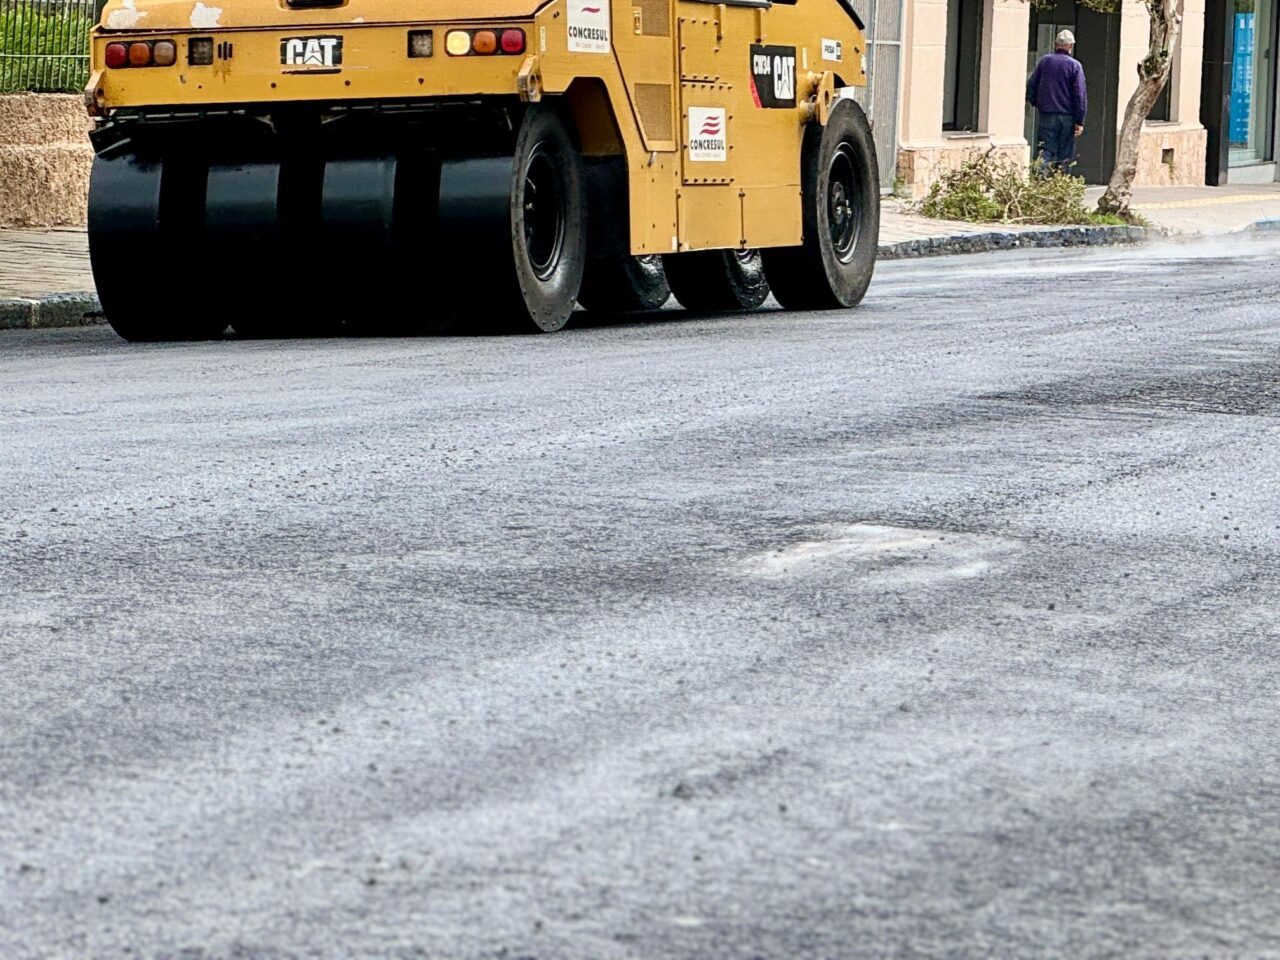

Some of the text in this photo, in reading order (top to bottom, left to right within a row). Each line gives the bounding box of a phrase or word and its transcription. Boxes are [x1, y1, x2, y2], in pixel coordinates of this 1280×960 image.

[568, 25, 608, 41] CONCRESUL
[285, 38, 337, 66] CAT
[773, 55, 796, 100] CAT
[690, 139, 725, 151] CONCRESUL
